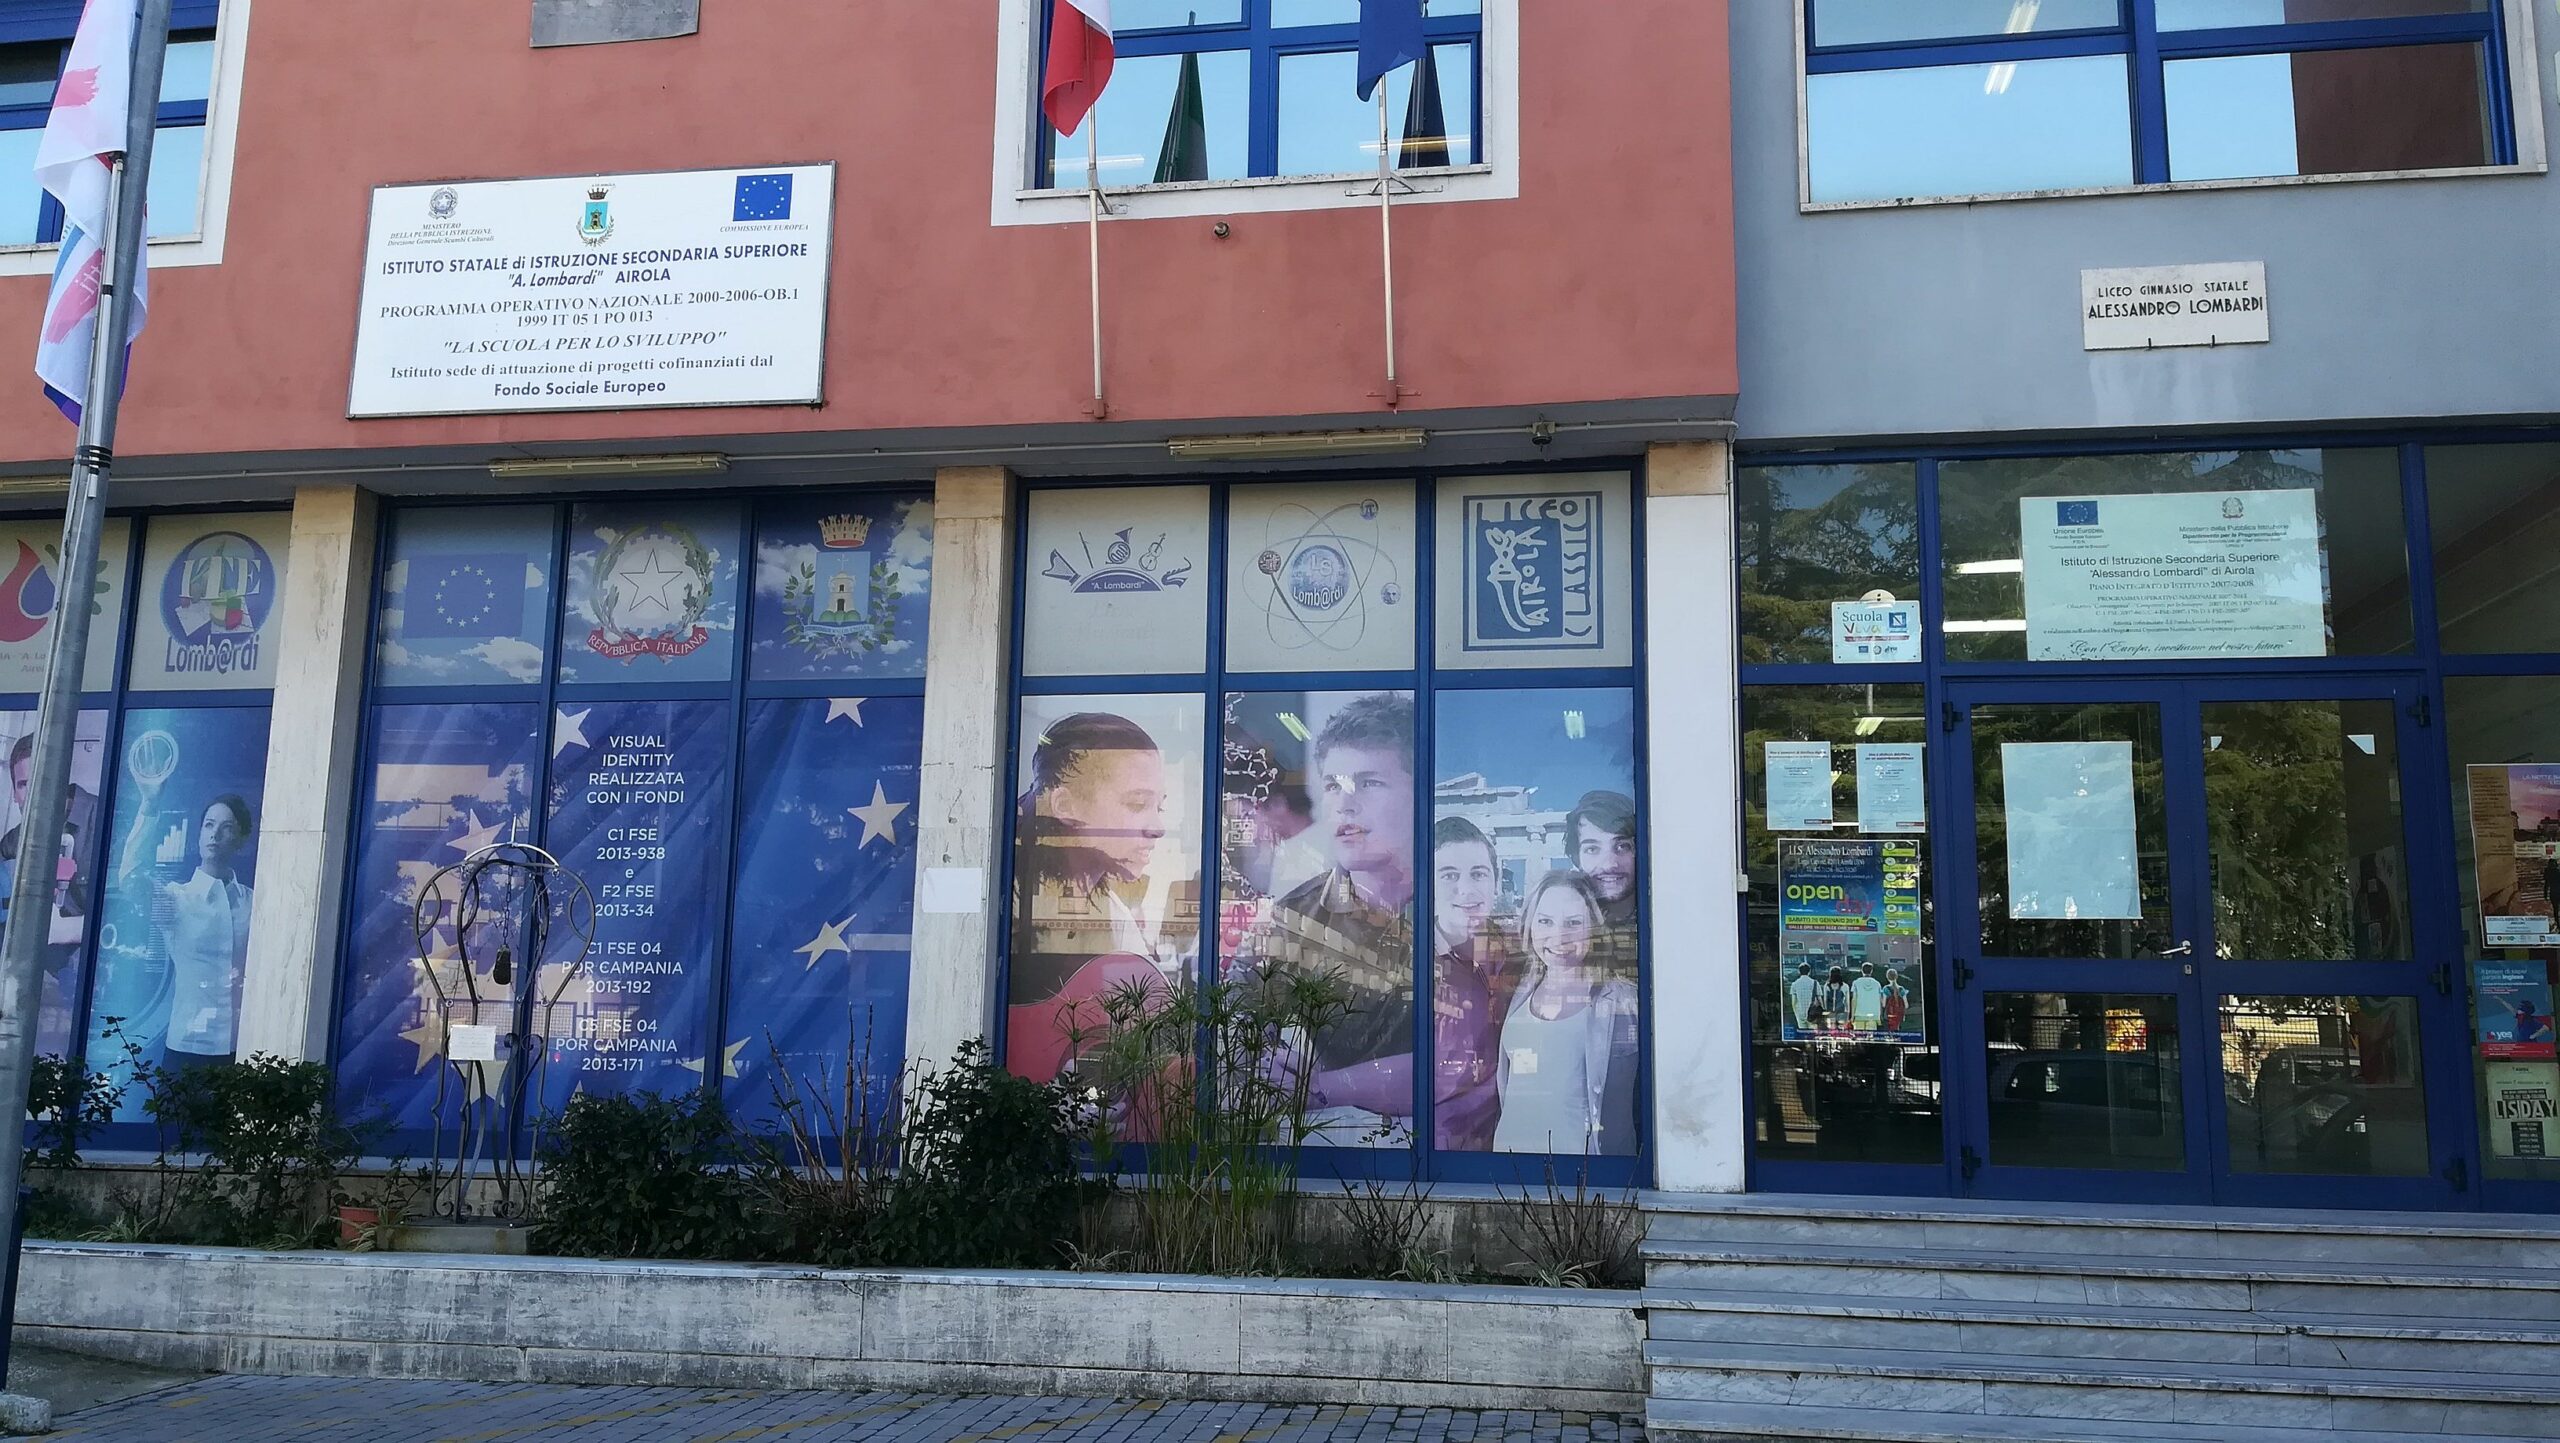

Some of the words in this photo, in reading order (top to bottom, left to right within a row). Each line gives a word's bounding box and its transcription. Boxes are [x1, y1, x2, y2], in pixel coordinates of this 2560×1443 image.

[390, 231, 413, 239] DELLA
[413, 230, 448, 238] PUBBLICA
[449, 228, 492, 236] ISTRUZIONE
[719, 224, 772, 233] COMMISSIONE
[773, 223, 809, 231] EUROPEA
[387, 238, 415, 246] Direzione
[416, 237, 443, 245] Generale
[467, 235, 495, 243] Culturali
[382, 259, 444, 275] ISTITUTO
[449, 257, 508, 273] STATALE
[512, 256, 526, 270] di
[530, 252, 618, 269] ISTRUZIONE
[622, 247, 719, 265] SECONDARIA
[724, 243, 808, 259] SUPERIORE
[508, 273, 526, 288] "A.
[530, 269, 604, 287] Lombardi"
[615, 268, 671, 284] AIROLA
[2098, 286, 2132, 298] LICEO
[2140, 283, 2193, 295] GINNASIO
[2204, 281, 2249, 293] STATALE
[379, 302, 487, 318] PROGRAMMA
[490, 297, 584, 313] OPERATIVO
[588, 292, 684, 309] NAZIONALE
[687, 288, 799, 304] 2000-2006-OB.1
[2088, 300, 2181, 319] ALESSANDRO
[2190, 296, 2263, 314] LOMBARDI
[517, 315, 548, 327] 1999
[552, 314, 569, 326] IT
[572, 313, 588, 325] 05
[593, 313, 599, 325] 1
[604, 311, 626, 324] PO
[629, 310, 653, 323] 013
[444, 341, 475, 354] "LA
[478, 338, 551, 353] SCUOLA
[555, 336, 592, 350] PER
[595, 335, 620, 349] LO
[623, 331, 728, 348] SVILUPPO"
[390, 366, 442, 379] Istituto
[446, 365, 477, 377] sede
[481, 364, 495, 376] di
[499, 362, 575, 376] attuazione
[579, 361, 593, 374] di
[597, 358, 654, 374] progetti
[659, 355, 746, 371] cofinanziati
[750, 355, 773, 368] dal
[494, 382, 541, 397] Fondo
[546, 380, 599, 395] Sociale
[604, 381, 666, 396] Europeo
[2061, 557, 2096, 566] Istituto
[2100, 556, 2109, 565] di
[2112, 556, 2163, 565] Istruzione
[2165, 553, 2226, 564] Secondaria
[2228, 553, 2280, 564] Superiore
[2153, 567, 2208, 577] Lombardi"
[2211, 566, 2222, 575] di
[2224, 566, 2255, 575] Airola
[1293, 586, 1344, 609] Lomb@rdi
[1842, 611, 1883, 622] Scuola
[656, 633, 708, 654] ITALIANA
[165, 635, 259, 674] Lomb@rdi
[609, 735, 665, 748] VISUAL
[602, 754, 674, 767] IDENTITY
[589, 772, 684, 785] REALIZZATA
[587, 791, 621, 804] CON
[625, 791, 630, 804] I
[634, 791, 684, 803] FONDI
[607, 828, 623, 841] C1
[629, 828, 658, 841] FSE
[596, 847, 666, 860] 2013-938
[1842, 845, 1873, 856] Lombardi
[625, 868, 634, 879] e
[602, 885, 620, 897] F2
[625, 885, 655, 897] FSE
[1786, 884, 1843, 905] open
[595, 904, 654, 917] 2013-34
[587, 942, 602, 955] C1
[607, 942, 636, 955] FSE
[641, 942, 662, 955] 04
[561, 961, 595, 974] POR
[599, 961, 683, 974] CAMPANIA
[585, 980, 651, 994] 2013-192
[602, 1019, 632, 1032] FSE
[636, 1019, 658, 1032] 04
[555, 1038, 588, 1051] POR
[593, 1038, 678, 1052] CAMPANIA
[581, 1058, 643, 1071] 2013-171
